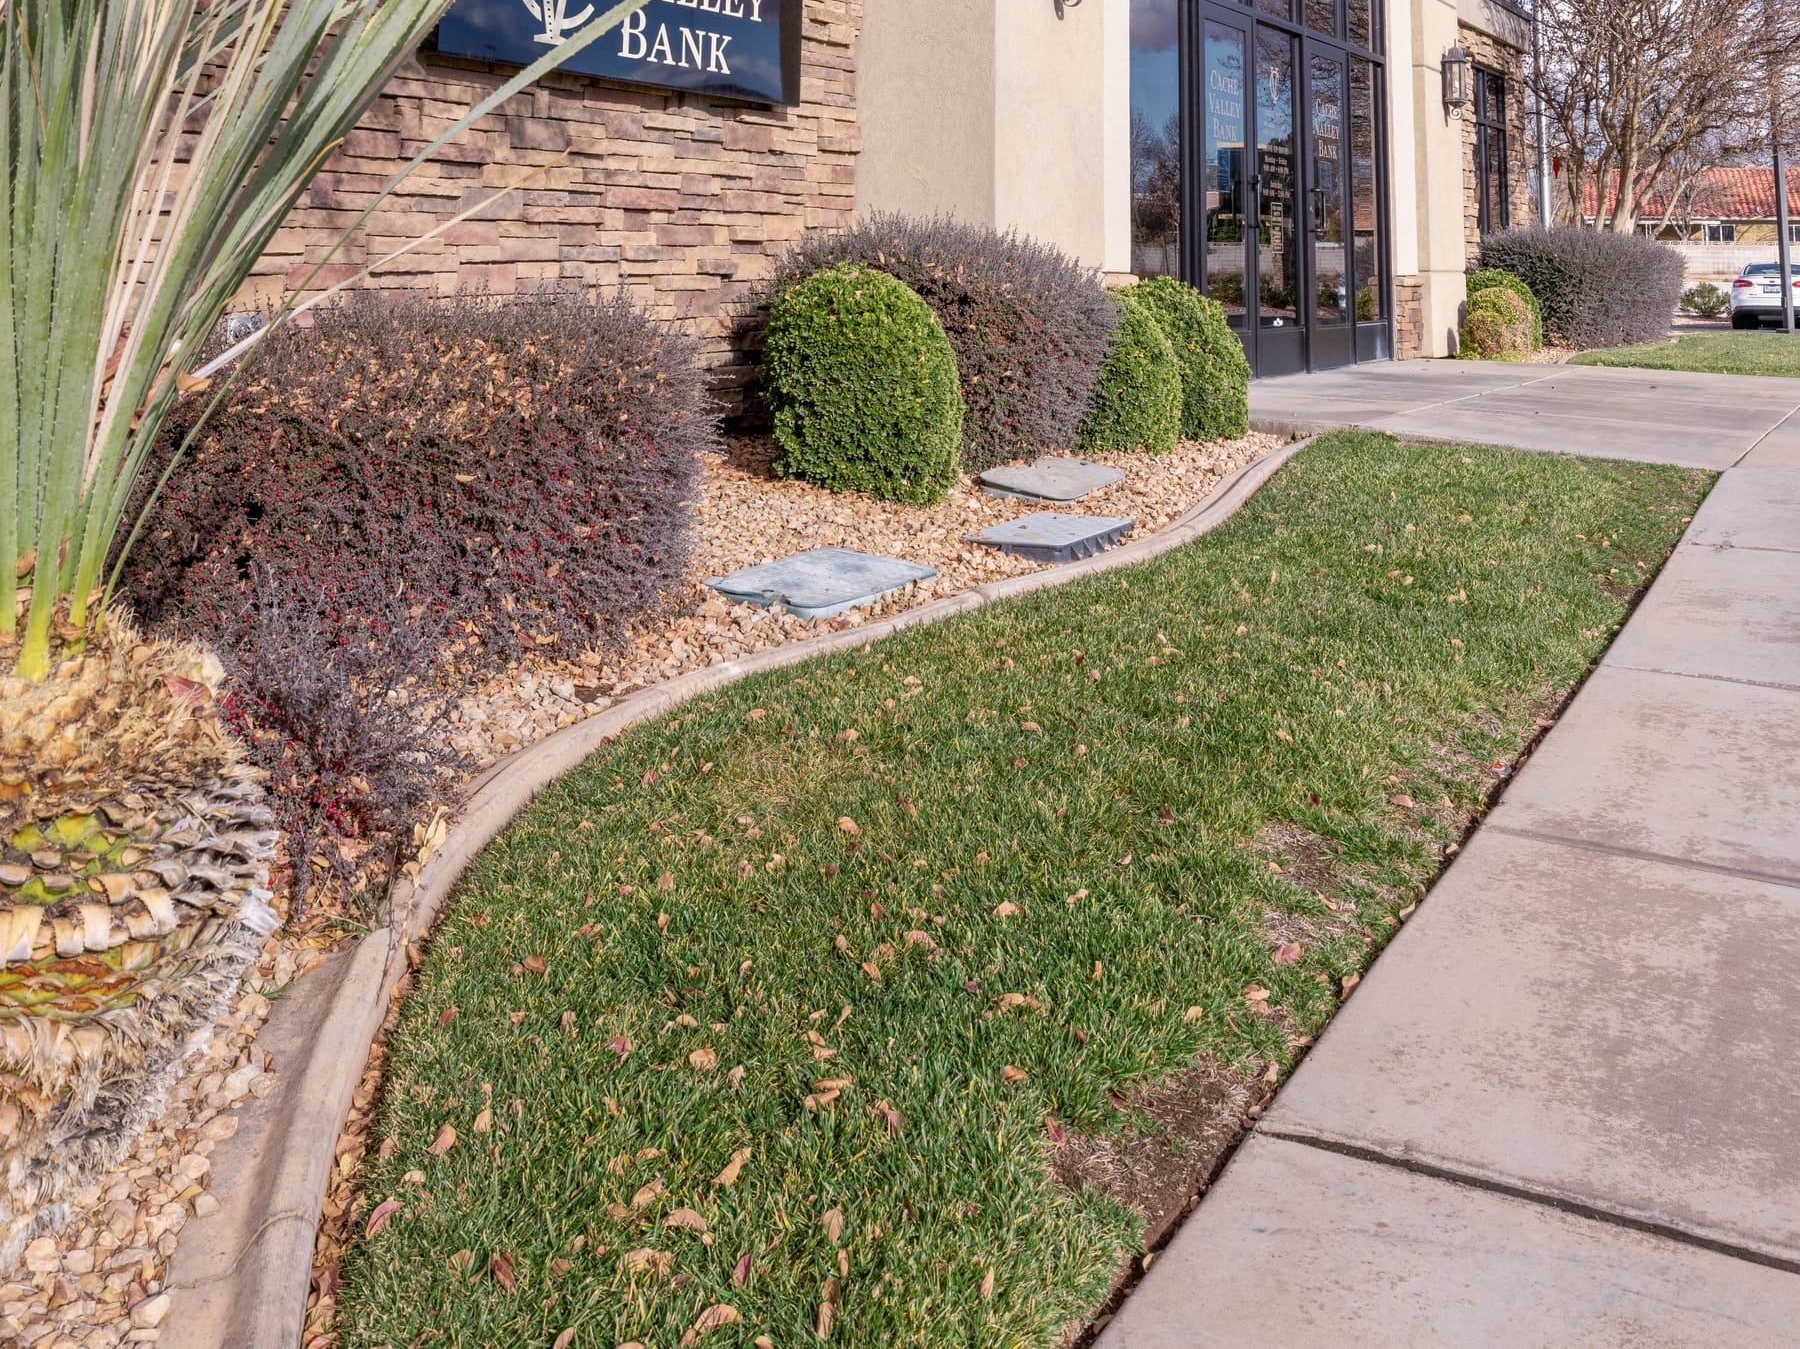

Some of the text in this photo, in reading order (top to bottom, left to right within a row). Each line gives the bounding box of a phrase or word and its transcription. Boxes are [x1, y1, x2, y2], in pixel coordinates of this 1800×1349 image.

[617, 8, 732, 75] BANK
[1210, 69, 1240, 96] CACHE
[1208, 92, 1241, 119] VALLEY
[1315, 98, 1339, 120] CACHE
[1213, 117, 1238, 142] BANK
[1315, 119, 1340, 140] VALLEY
[1318, 140, 1338, 160] BANK
